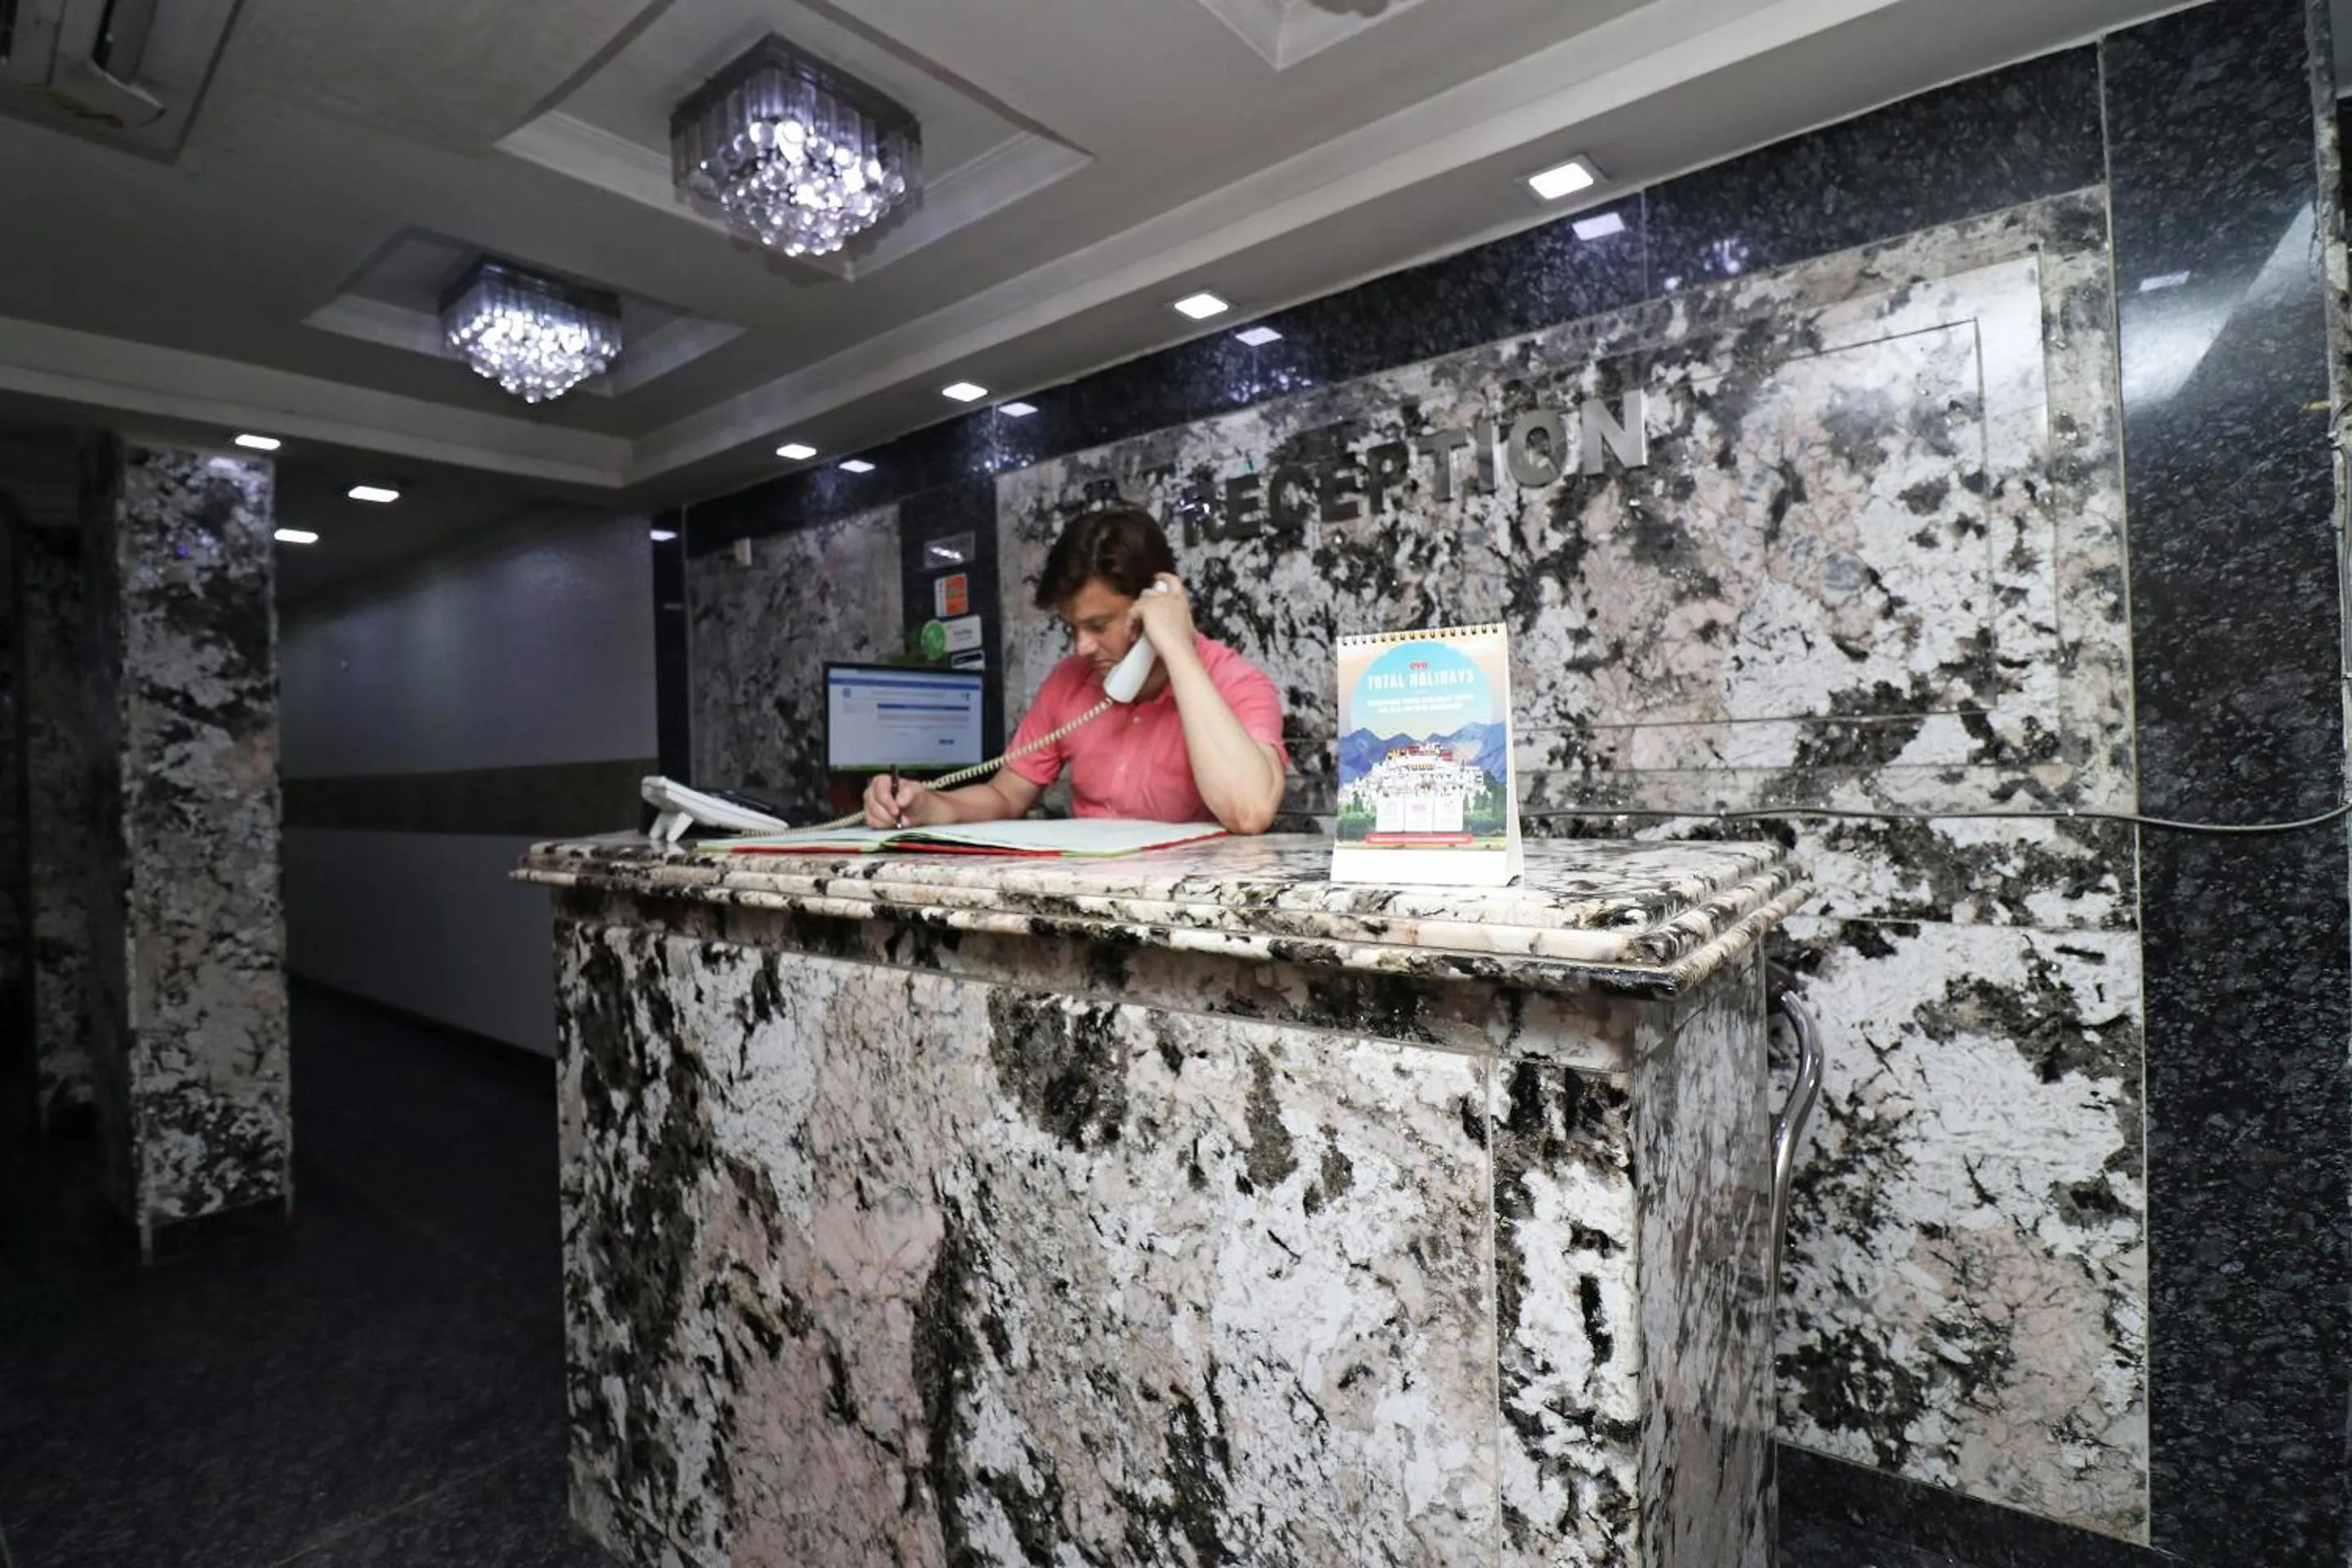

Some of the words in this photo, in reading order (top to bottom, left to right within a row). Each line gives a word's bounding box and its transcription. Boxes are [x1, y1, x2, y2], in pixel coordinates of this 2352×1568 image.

[1182, 389, 1648, 548] RECEPTION
[1367, 674, 1405, 690] TOTAL
[1409, 668, 1475, 688] HOLIDAYS
